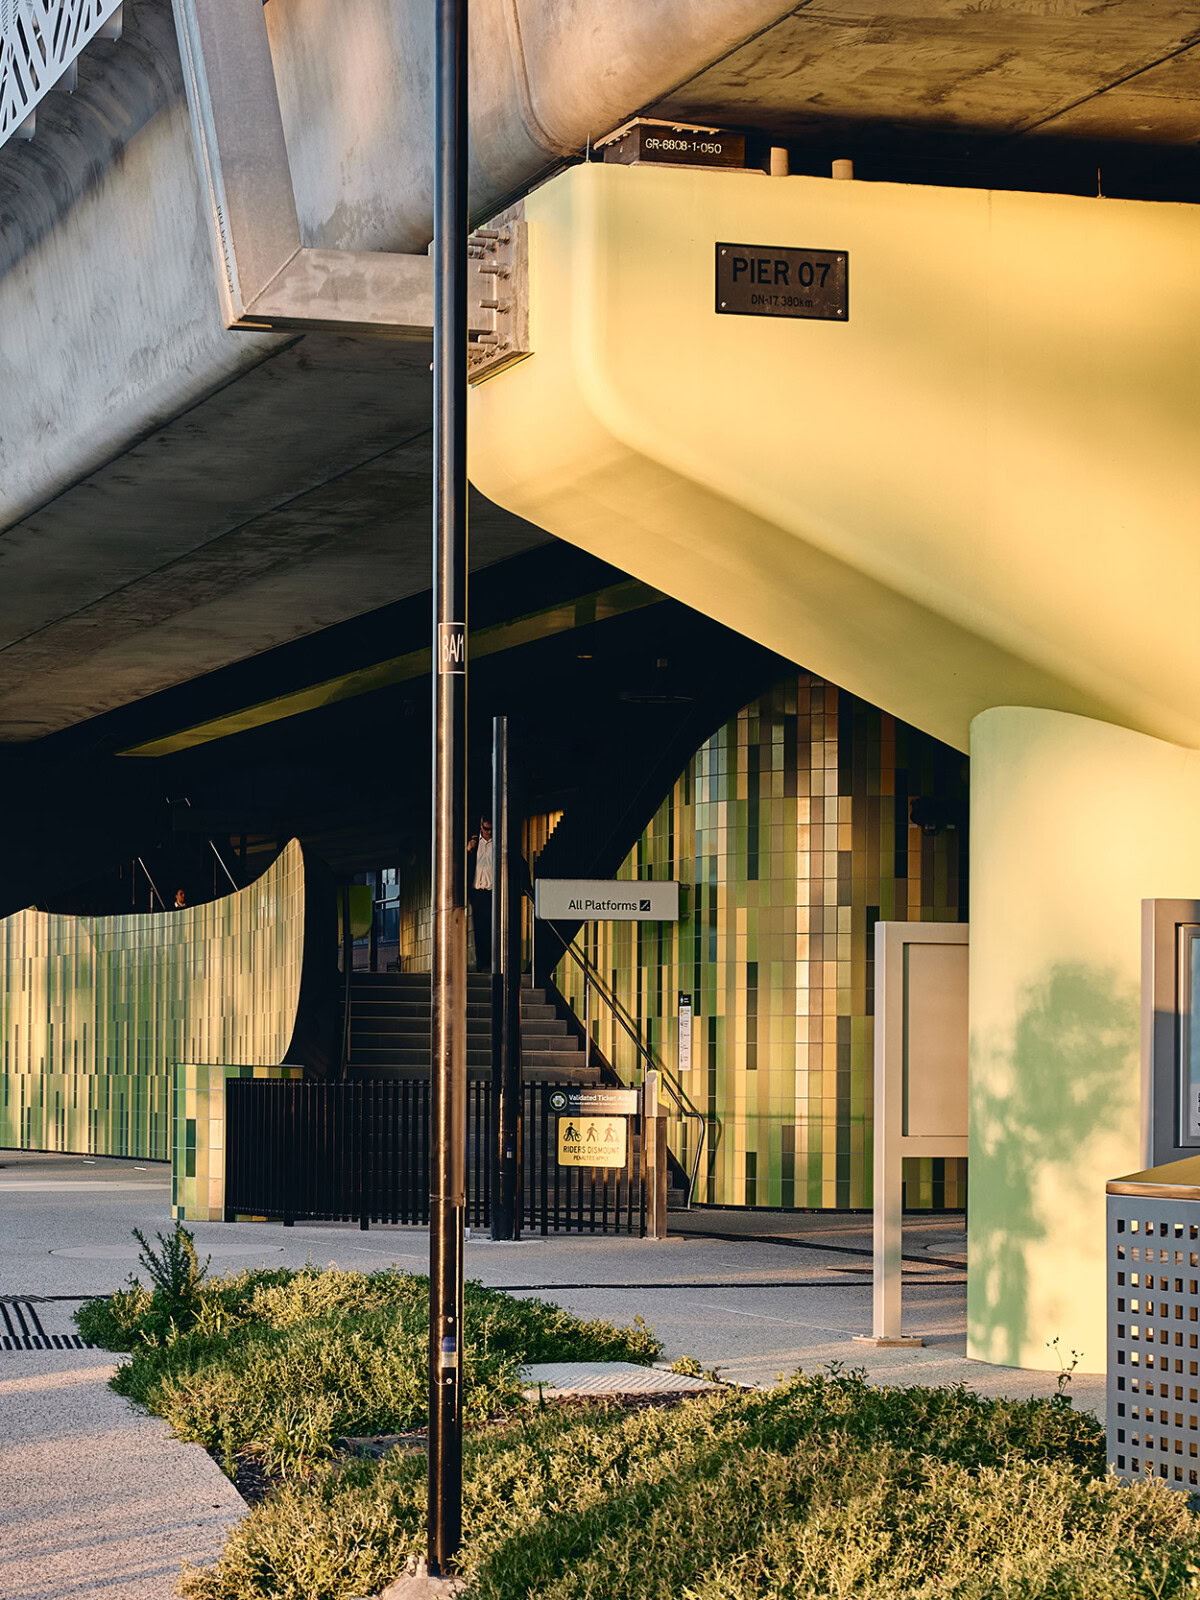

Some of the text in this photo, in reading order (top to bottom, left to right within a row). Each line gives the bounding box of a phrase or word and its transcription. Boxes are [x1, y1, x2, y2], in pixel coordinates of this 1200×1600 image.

[645, 138, 722, 154] GR-6808-1-050
[732, 257, 832, 288] PIER 07
[568, 899, 638, 911] All Platforms
[563, 1145, 620, 1155] RIDERS DISMOUNT
